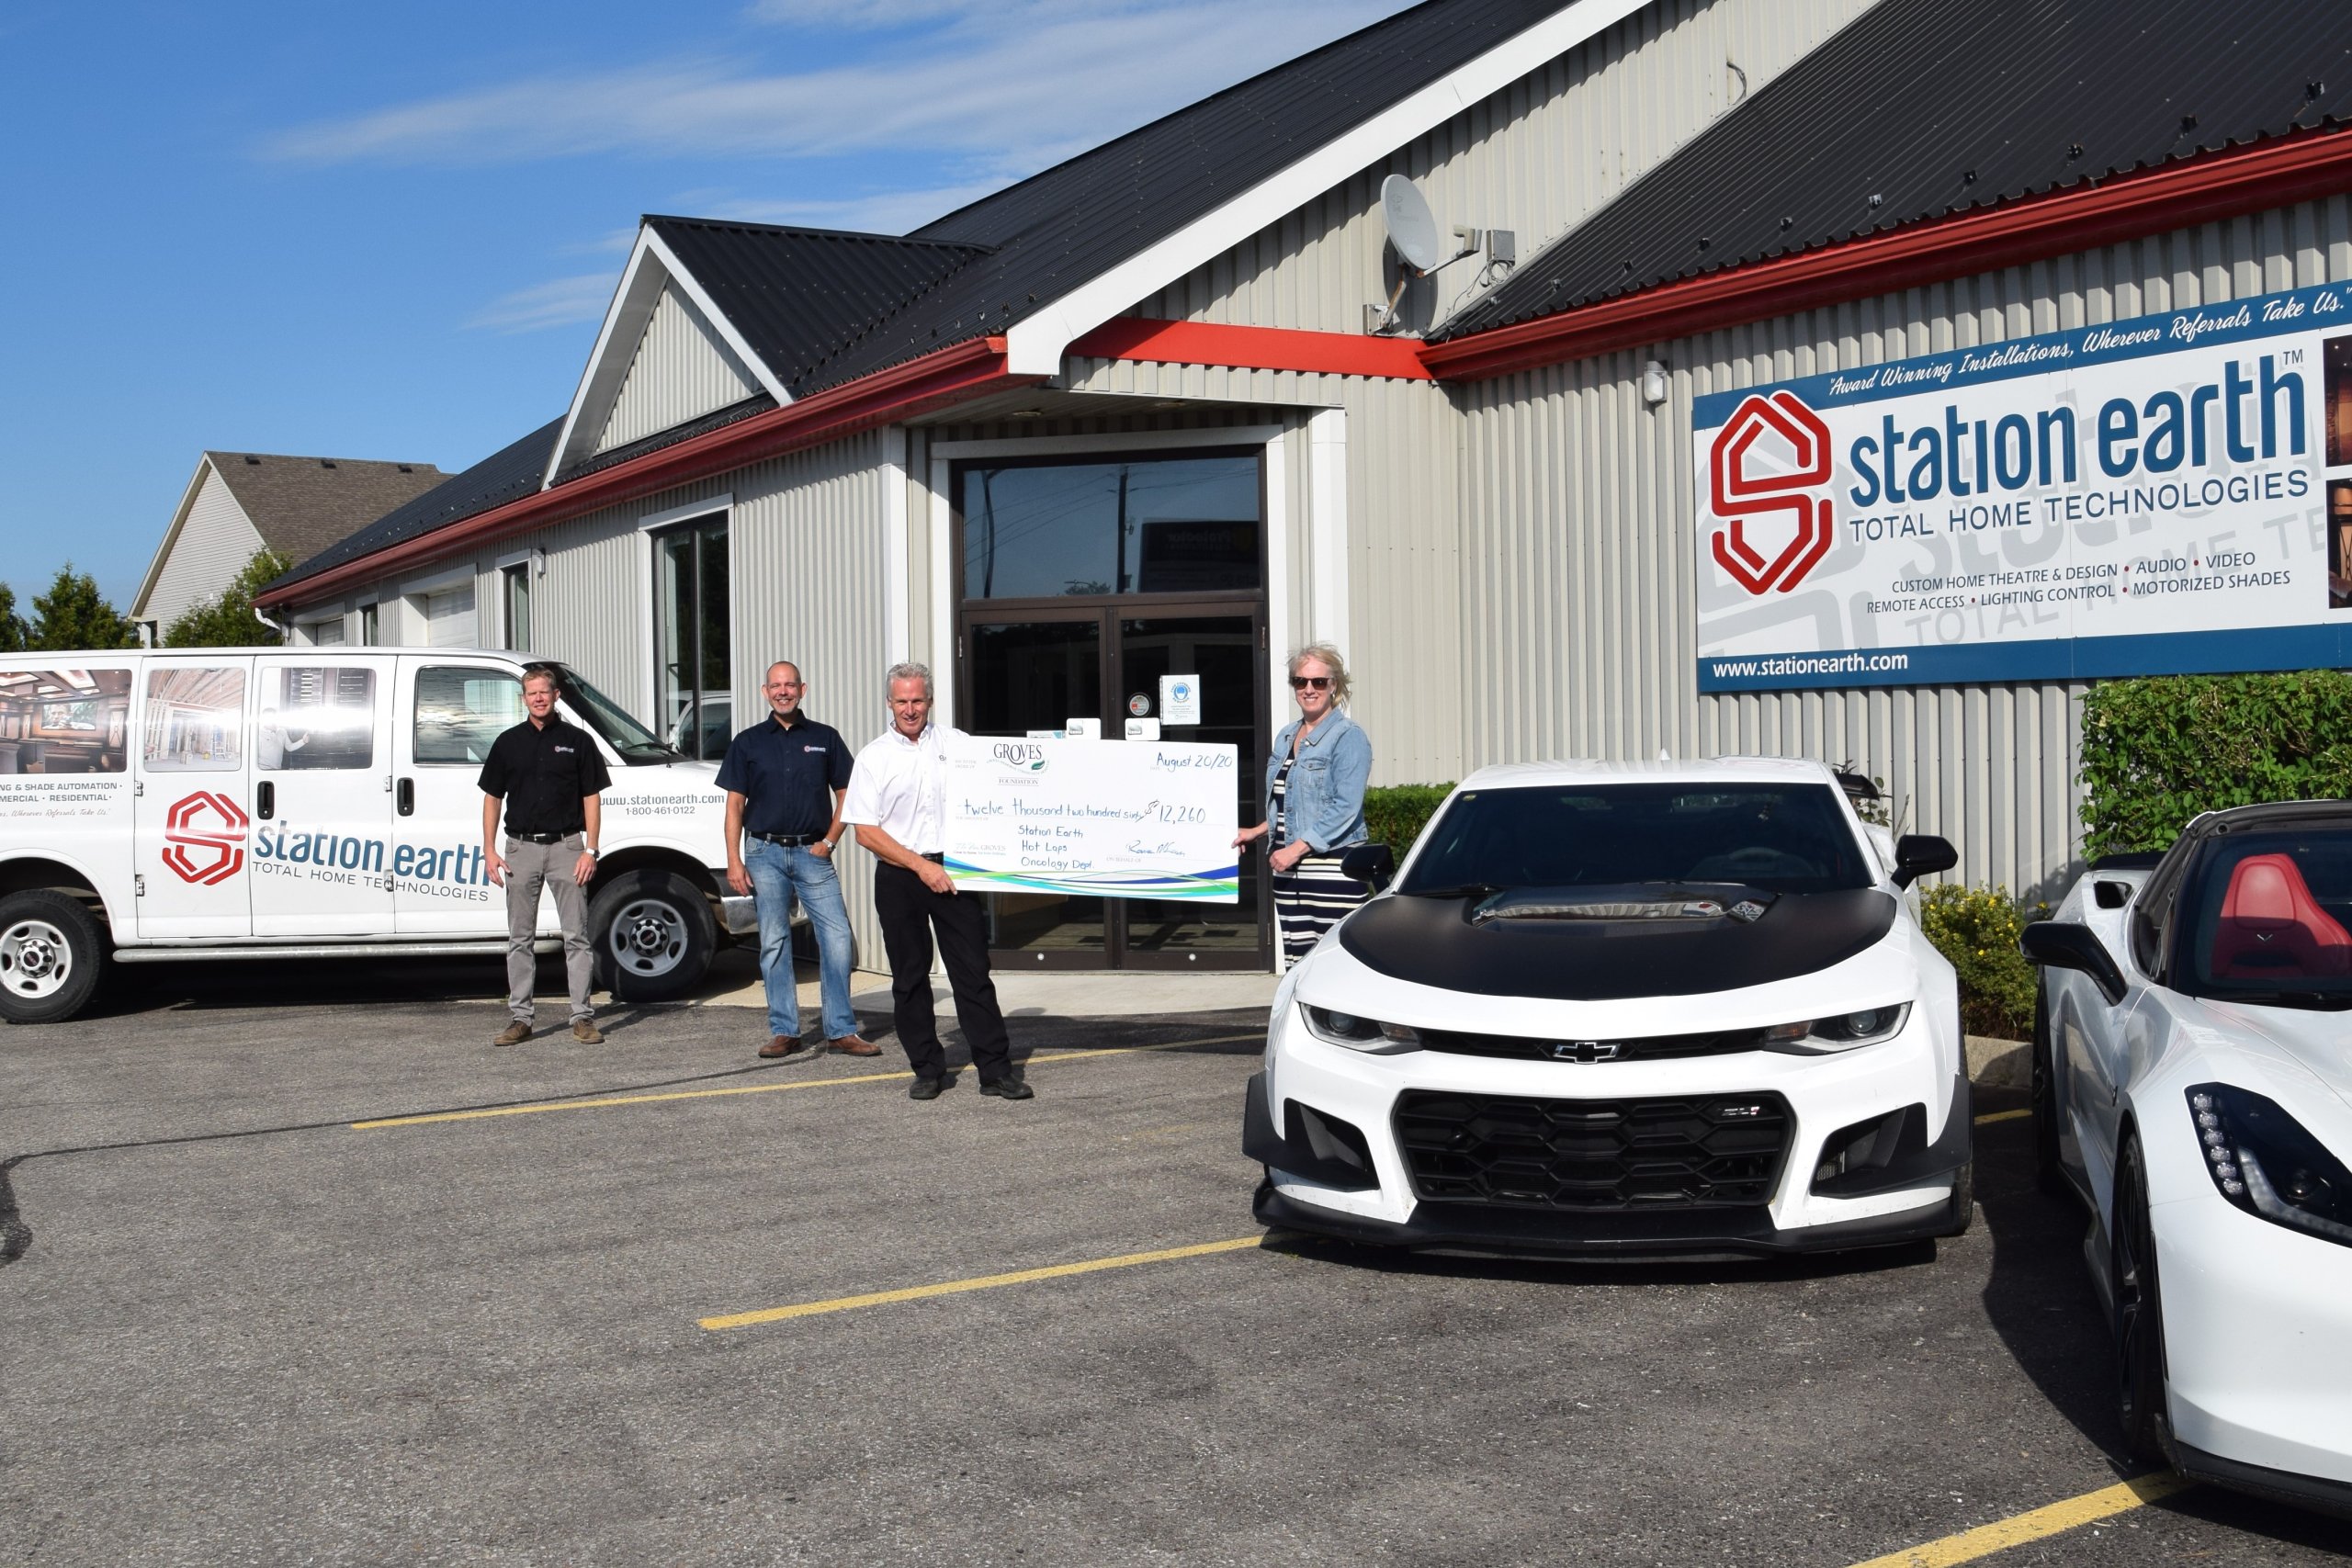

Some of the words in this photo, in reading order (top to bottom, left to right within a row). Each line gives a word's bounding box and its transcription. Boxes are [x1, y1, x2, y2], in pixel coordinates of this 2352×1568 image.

[1881, 359, 1953, 389] Winning
[1958, 341, 2075, 374] Installations,
[2083, 326, 2161, 353] Wherever
[2168, 305, 2252, 343] Referrals
[2262, 295, 2304, 321] Take
[1850, 404, 2076, 508] station
[2098, 355, 2306, 478] earth
[2283, 349, 2303, 366] TM
[1849, 513, 1934, 543] TOTAL
[1949, 502, 2031, 534] HOME
[2044, 469, 2309, 523] TECHNOLOGIES
[1892, 575, 1943, 594] CUSTOM
[1946, 573, 1985, 590] HOME
[1988, 568, 2049, 587] THEATRE
[2052, 567, 2062, 581] &
[2065, 562, 2118, 581] DESIGN
[2136, 558, 2187, 574] AUDIO
[2206, 551, 2256, 569] VIDEO
[1867, 596, 1917, 614] REMOTE
[1919, 593, 1965, 610] ACCESS
[1981, 589, 2044, 606] LIGHTING
[2047, 584, 2116, 602] CONTROL
[2132, 575, 2224, 596] MOTORIZED
[2228, 570, 2291, 589] SHADES
[1712, 652, 1909, 678] www.stationearth.com
[993, 742, 1043, 765] GROVES
[1157, 751, 1193, 775] August
[1194, 752, 1233, 770] 20/20
[998, 778, 1039, 786] FOUNDATION
[965, 798, 1004, 816] twelve
[1012, 797, 1063, 817] thousand
[1066, 804, 1085, 817] two
[1086, 804, 1121, 818] hundred
[1123, 807, 1146, 822] sixty
[1017, 825, 1051, 836] Station
[1057, 825, 1083, 839] Earth
[254, 819, 385, 873] station
[393, 843, 491, 887] earth
[1022, 840, 1040, 852] Hot
[253, 861, 302, 878] TOTAL
[310, 869, 356, 886] HOME
[1021, 856, 1069, 872] Oncology
[1072, 859, 1095, 872] Dept.
